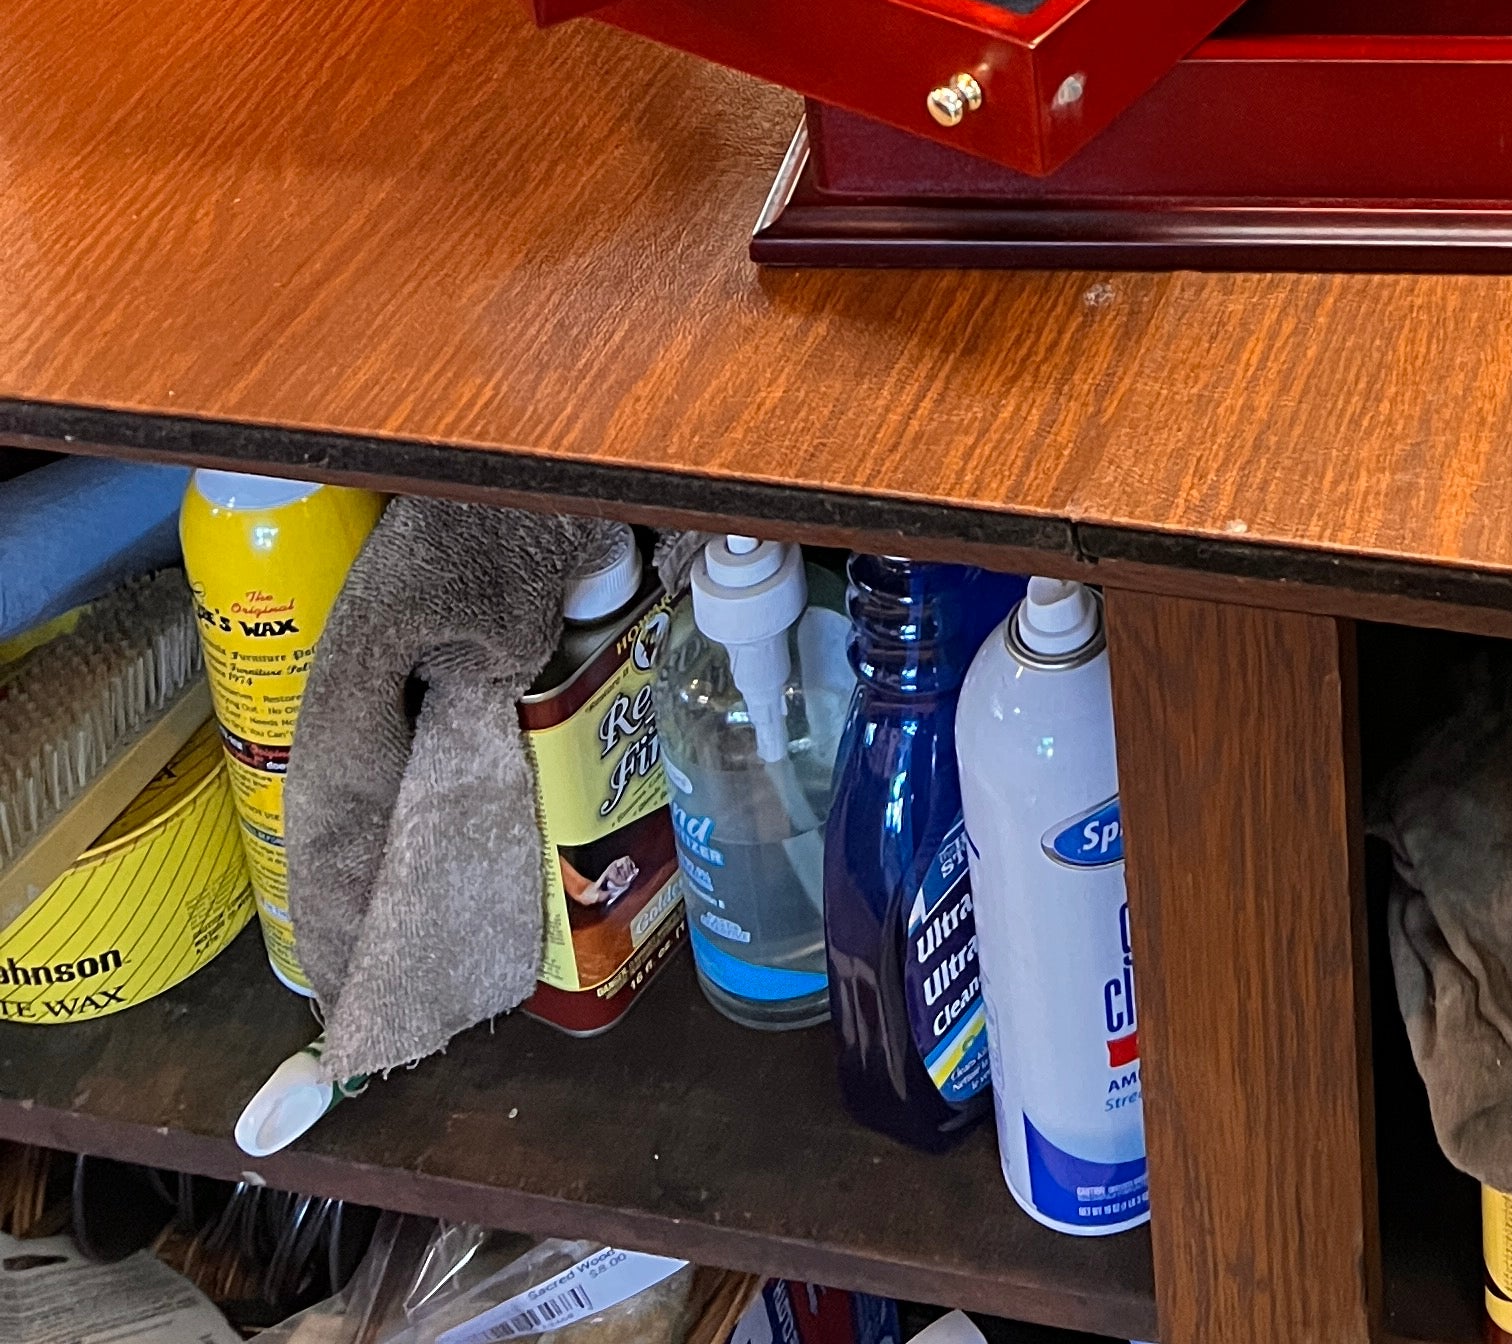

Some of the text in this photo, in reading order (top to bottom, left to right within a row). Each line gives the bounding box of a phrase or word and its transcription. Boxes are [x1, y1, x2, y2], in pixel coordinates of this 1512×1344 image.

[231, 597, 295, 619] Original
[238, 617, 300, 638] WAX
[1082, 820, 1123, 853] Sp
[41, 984, 128, 1018] WAX
[1108, 1071, 1141, 1093] AM
[1104, 1091, 1141, 1112] Stre
[527, 1247, 616, 1301] Sacred Wood
